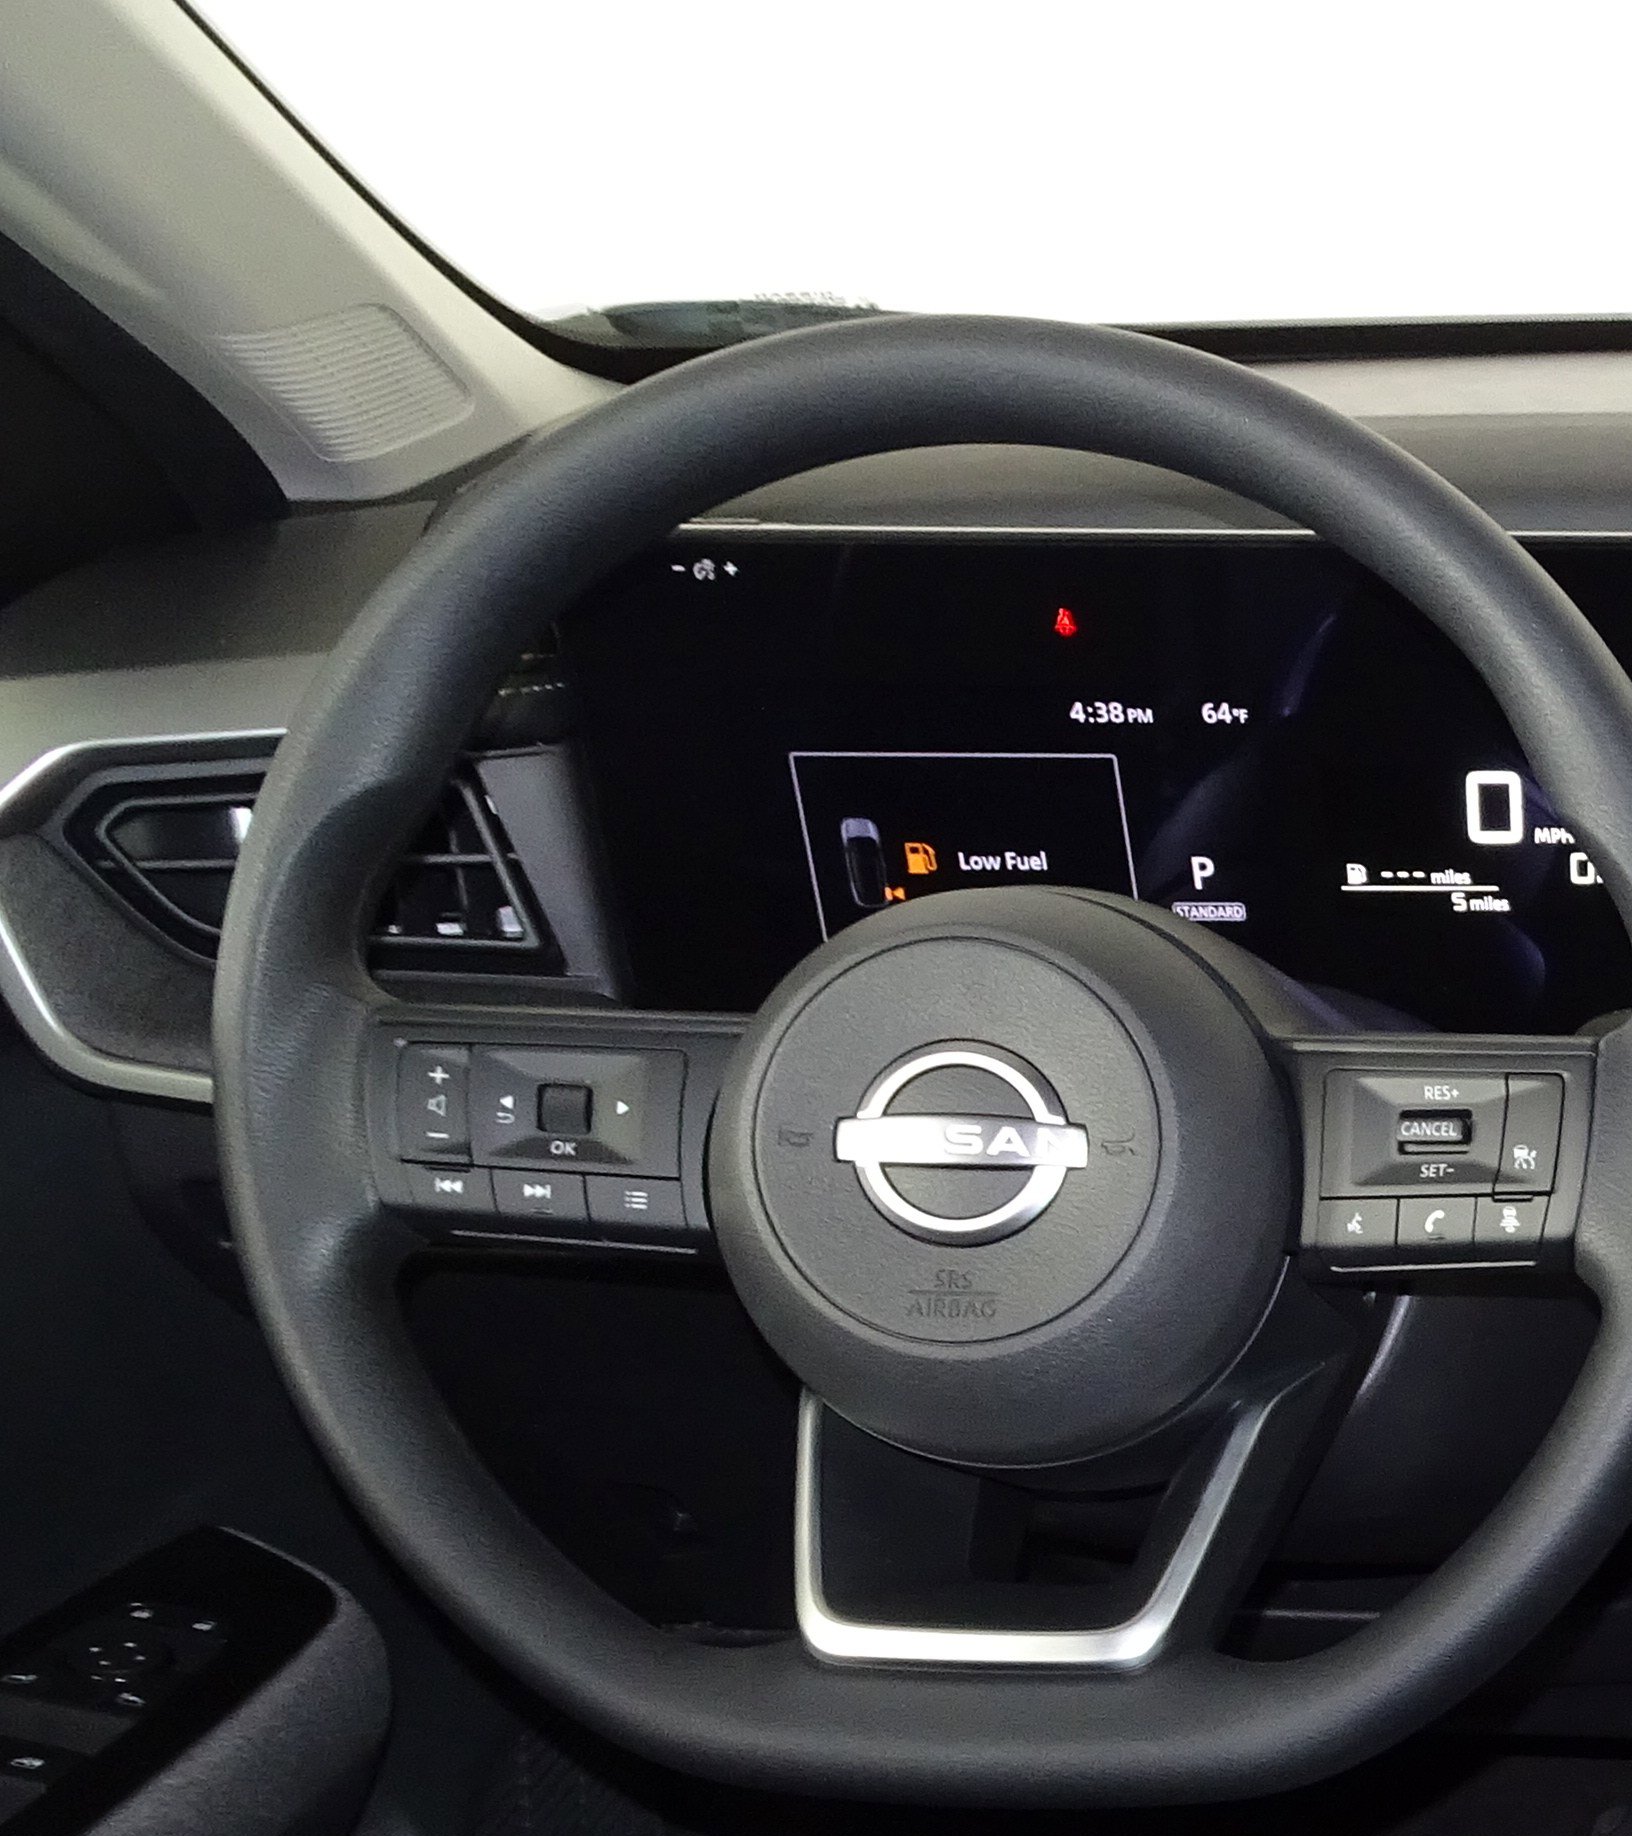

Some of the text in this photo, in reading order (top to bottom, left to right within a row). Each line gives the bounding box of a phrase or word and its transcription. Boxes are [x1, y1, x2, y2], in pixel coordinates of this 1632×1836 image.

[1069, 701, 1154, 724] 4:38 PM
[1466, 770, 1524, 844] 0
[957, 851, 1048, 872] Low Fuel
[1190, 855, 1215, 890] P
[1430, 868, 1474, 885] miles
[1176, 905, 1243, 918] STANDARD
[1451, 892, 1512, 912] 5 miles
[1424, 1085, 1460, 1100] RES+
[1400, 1121, 1458, 1137] CANCEL
[550, 1140, 577, 1157] OK
[934, 1268, 973, 1290] SRS
[906, 1298, 998, 1318] AIRBAG
